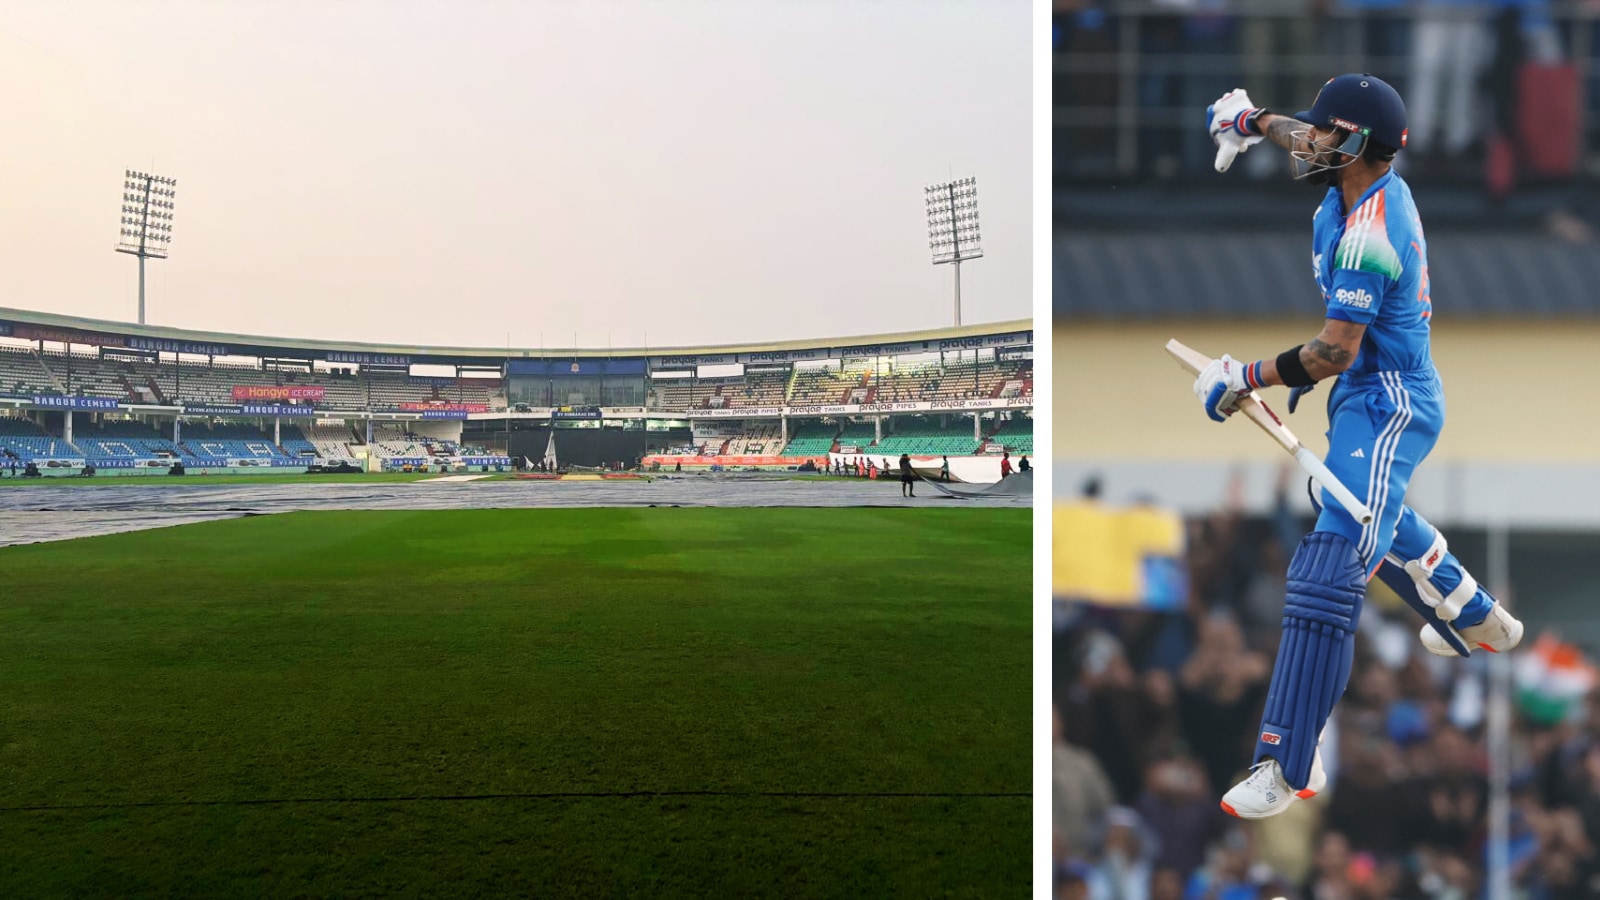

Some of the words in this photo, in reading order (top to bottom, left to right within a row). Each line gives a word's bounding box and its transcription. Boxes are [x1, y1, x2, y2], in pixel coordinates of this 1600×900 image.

[1335, 288, 1373, 303] apollo
[987, 336, 1015, 345] PIPES
[184, 344, 226, 355] CEMENT
[884, 345, 911, 353] TANKS
[792, 351, 815, 359] PIPES
[249, 386, 289, 399] Hangyo
[291, 388, 302, 397] ICE
[303, 389, 324, 397] CREAM
[34, 396, 76, 407] BANGUR
[80, 399, 117, 408] CEMENT
[243, 405, 279, 414] BANGUR
[282, 407, 313, 415] CEMENT
